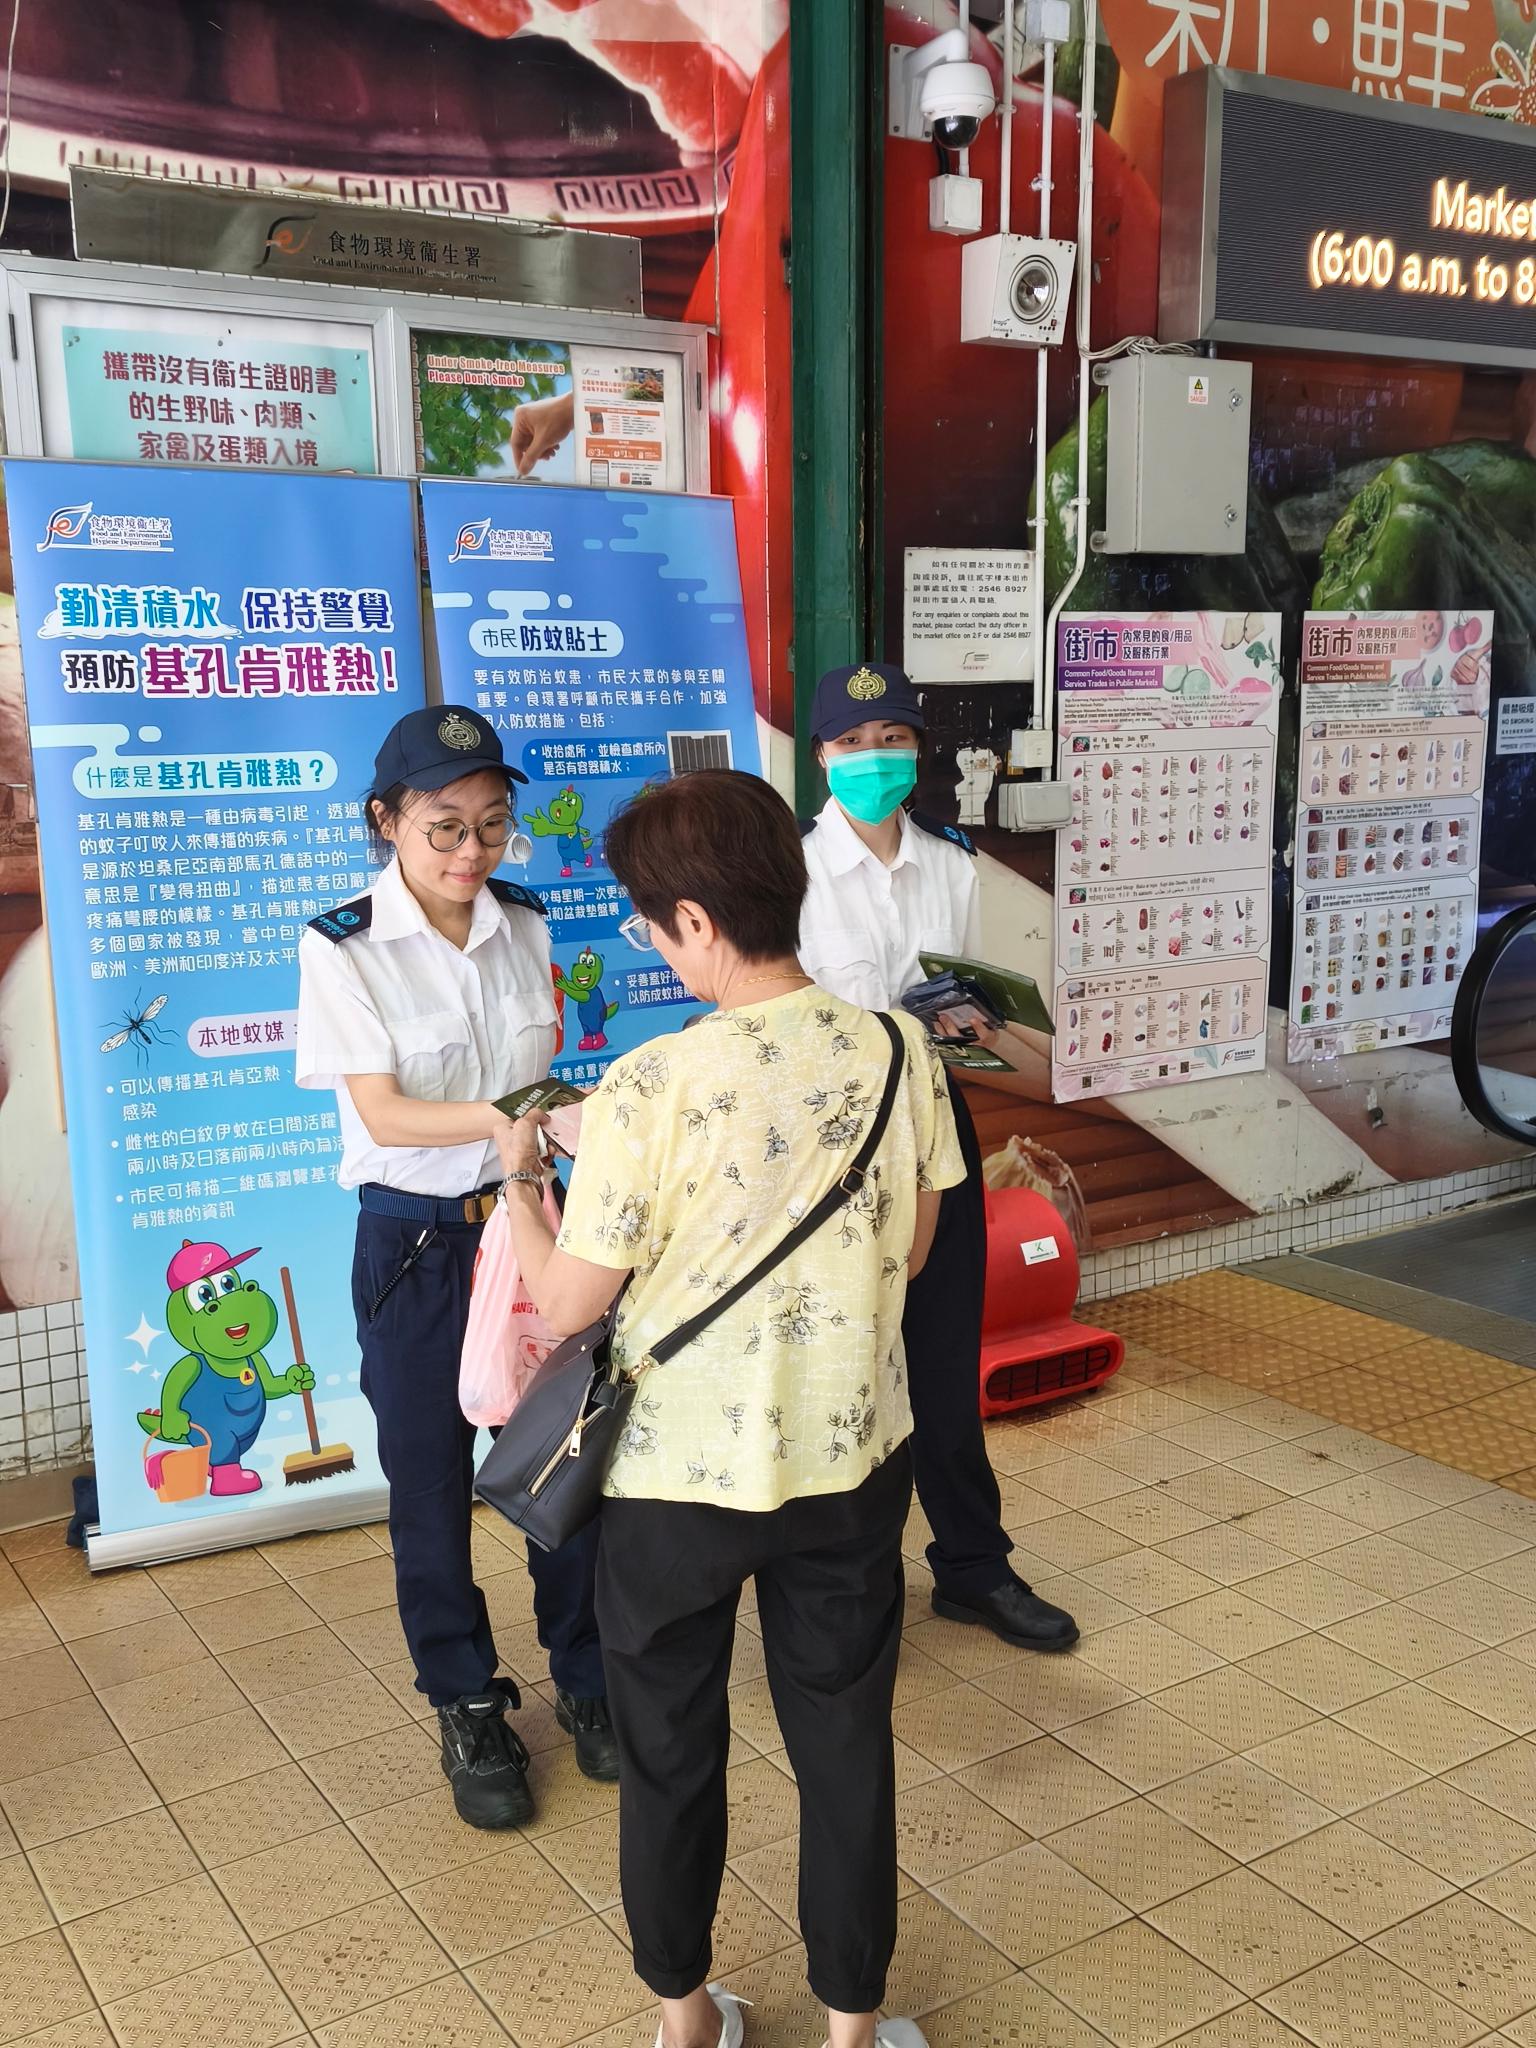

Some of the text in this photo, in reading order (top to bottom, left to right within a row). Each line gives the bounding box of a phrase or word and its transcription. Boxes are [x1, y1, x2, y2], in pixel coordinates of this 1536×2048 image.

[335, 257, 352, 268] and
[1311, 230, 1394, 288] (6:00
[1402, 254, 1467, 295] a.m.
[1476, 256, 1508, 299] to
[427, 355, 565, 374] Under Smoke-free Measures
[429, 371, 524, 386] Please Don't Smoke
[137, 430, 319, 467] 家禽及蛋類入境
[92, 538, 159, 547] Hygiene Department
[124, 531, 171, 539] Environmental
[978, 585, 1001, 593] 2546
[1005, 585, 1027, 593] 8927
[60, 586, 392, 630] 勤清積水 保持警覺
[936, 611, 960, 619] enquiries
[971, 611, 1000, 619] complaints
[934, 622, 953, 630] please
[989, 622, 1001, 630] duty
[482, 626, 608, 652] 市民防蚊貼士
[1122, 629, 1193, 643] 內常見的食/用品
[1308, 627, 1353, 656] 街市
[1065, 629, 1118, 662] 街市
[1122, 646, 1170, 660] 及服務行業
[1064, 668, 1156, 678] Common Food/Goods Items and
[1306, 664, 1329, 672] Common
[1064, 680, 1087, 688] Service
[1087, 680, 1108, 688] Trades
[1115, 679, 1134, 687] Public
[1134, 678, 1158, 687] Markets
[1366, 672, 1387, 680] Markets
[86, 759, 324, 791] 什麼是基孔肯雅熱？
[543, 760, 631, 776] 是否有容器積水；
[77, 801, 368, 831] 基孔肯雅熱是一種由病毒引起，透過
[122, 1102, 157, 1122] 感染
[132, 1201, 236, 1231] 肯雅熱的資訊
